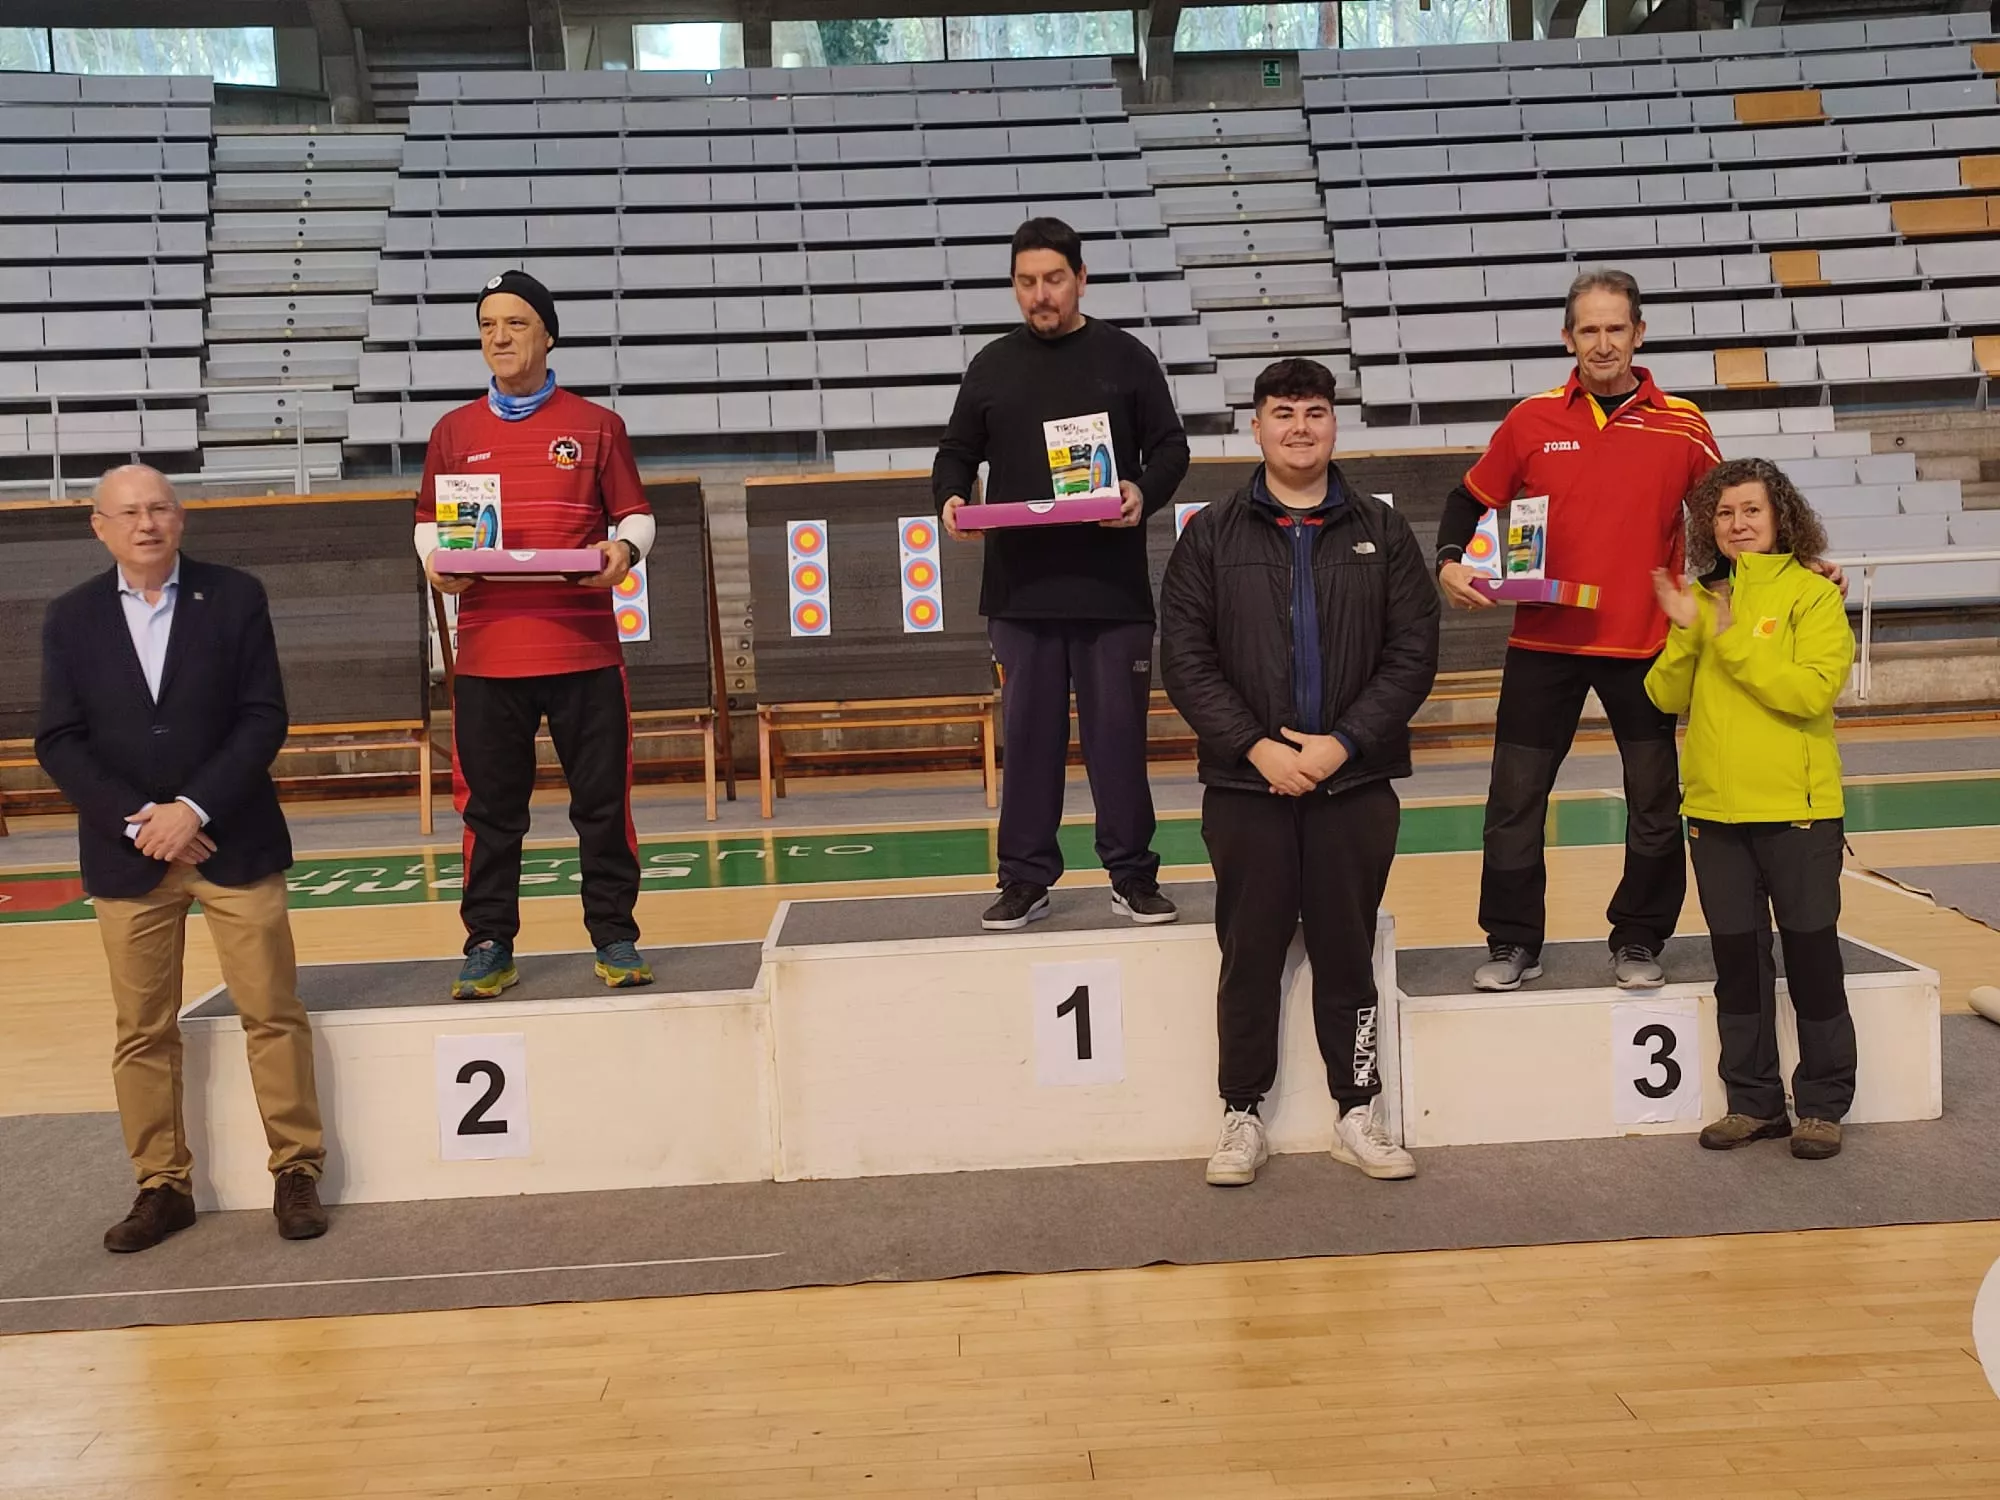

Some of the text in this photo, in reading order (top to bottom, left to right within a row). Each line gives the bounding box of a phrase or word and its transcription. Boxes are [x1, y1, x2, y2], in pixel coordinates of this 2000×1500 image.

[1056, 985, 1092, 1060] 1
[455, 1059, 508, 1136] 2
[1632, 1023, 1682, 1099] 3
